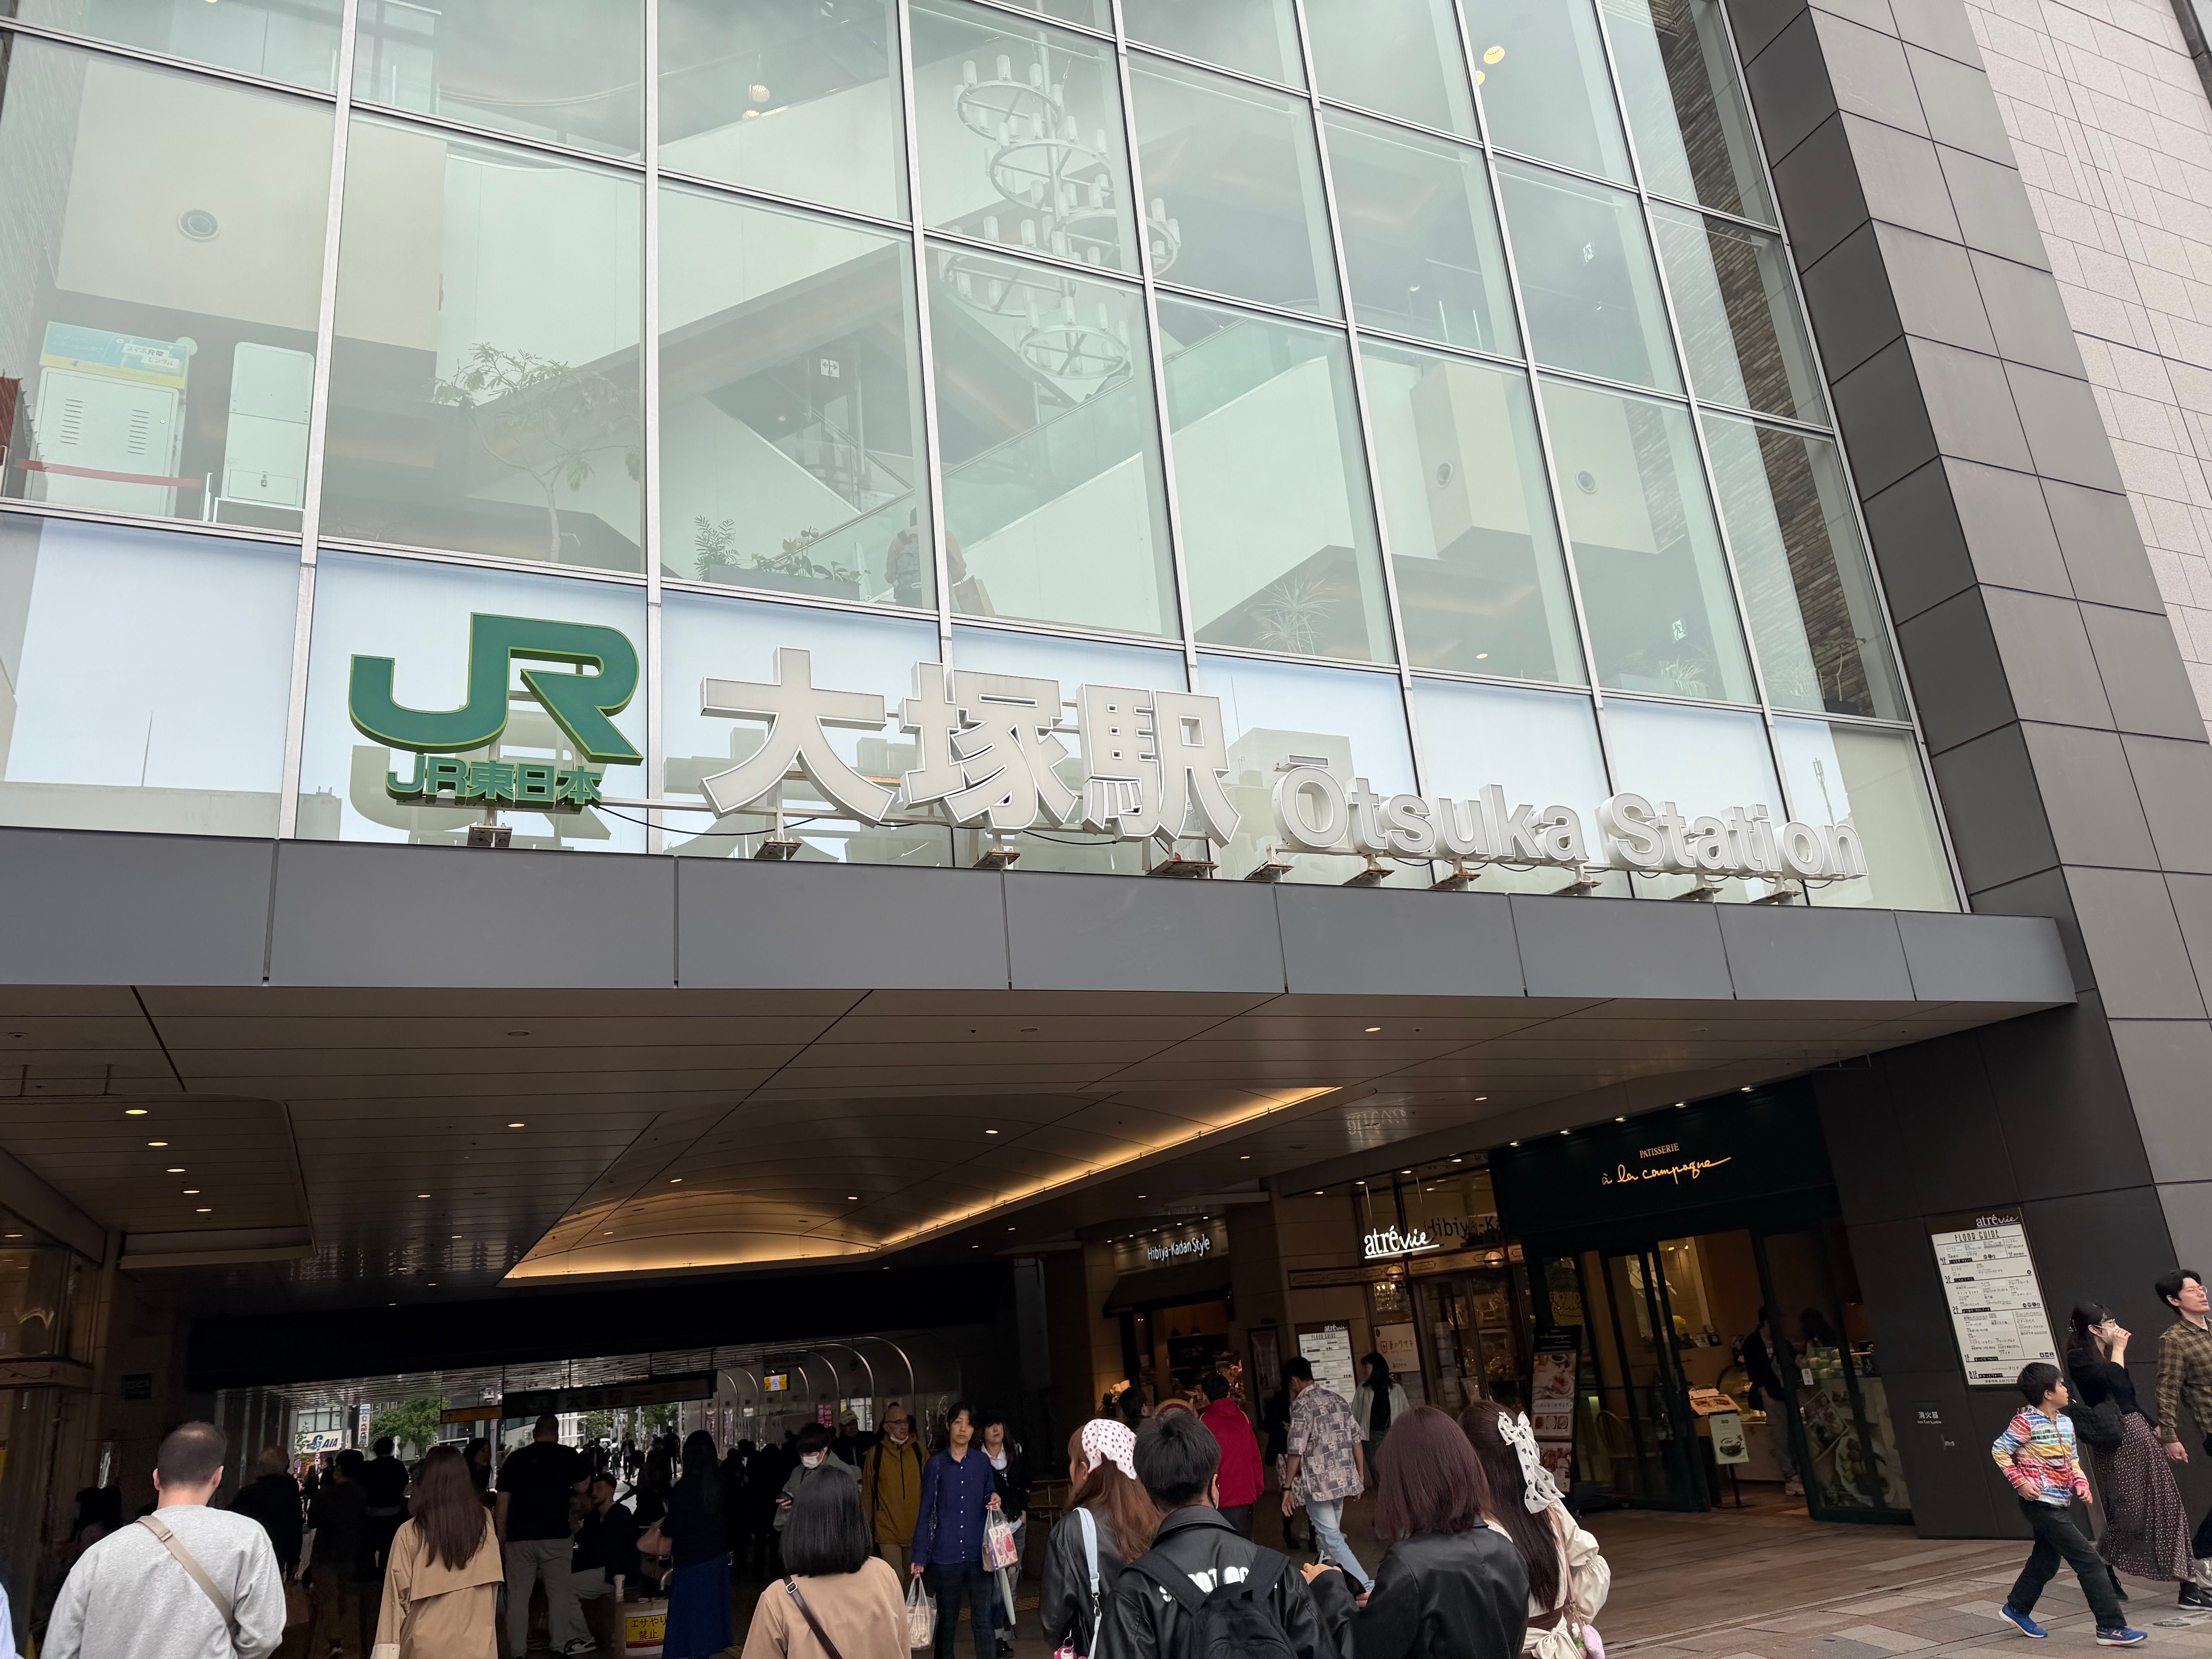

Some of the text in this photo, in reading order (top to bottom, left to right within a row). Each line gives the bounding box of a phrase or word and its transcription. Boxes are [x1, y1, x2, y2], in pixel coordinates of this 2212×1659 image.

[127, 345, 164, 357] スマホ充電
[149, 357, 174, 366] レンタル
[349, 612, 643, 765] JR
[700, 646, 1242, 848] 大塚駅
[386, 752, 603, 810] JR東日本
[1273, 754, 1869, 883] Ōtsuka Station
[1640, 1143, 1679, 1158] PATISSERIE
[1602, 1157, 1731, 1185] à la campagne
[1954, 1229, 2000, 1242] FLOOR GUIDE
[1147, 1233, 1210, 1261] Hibiya-Kadan Style
[1952, 1306, 1959, 1314] 2F
[632, 1616, 666, 1628] エサやり
[639, 1629, 658, 1640] 禁止
